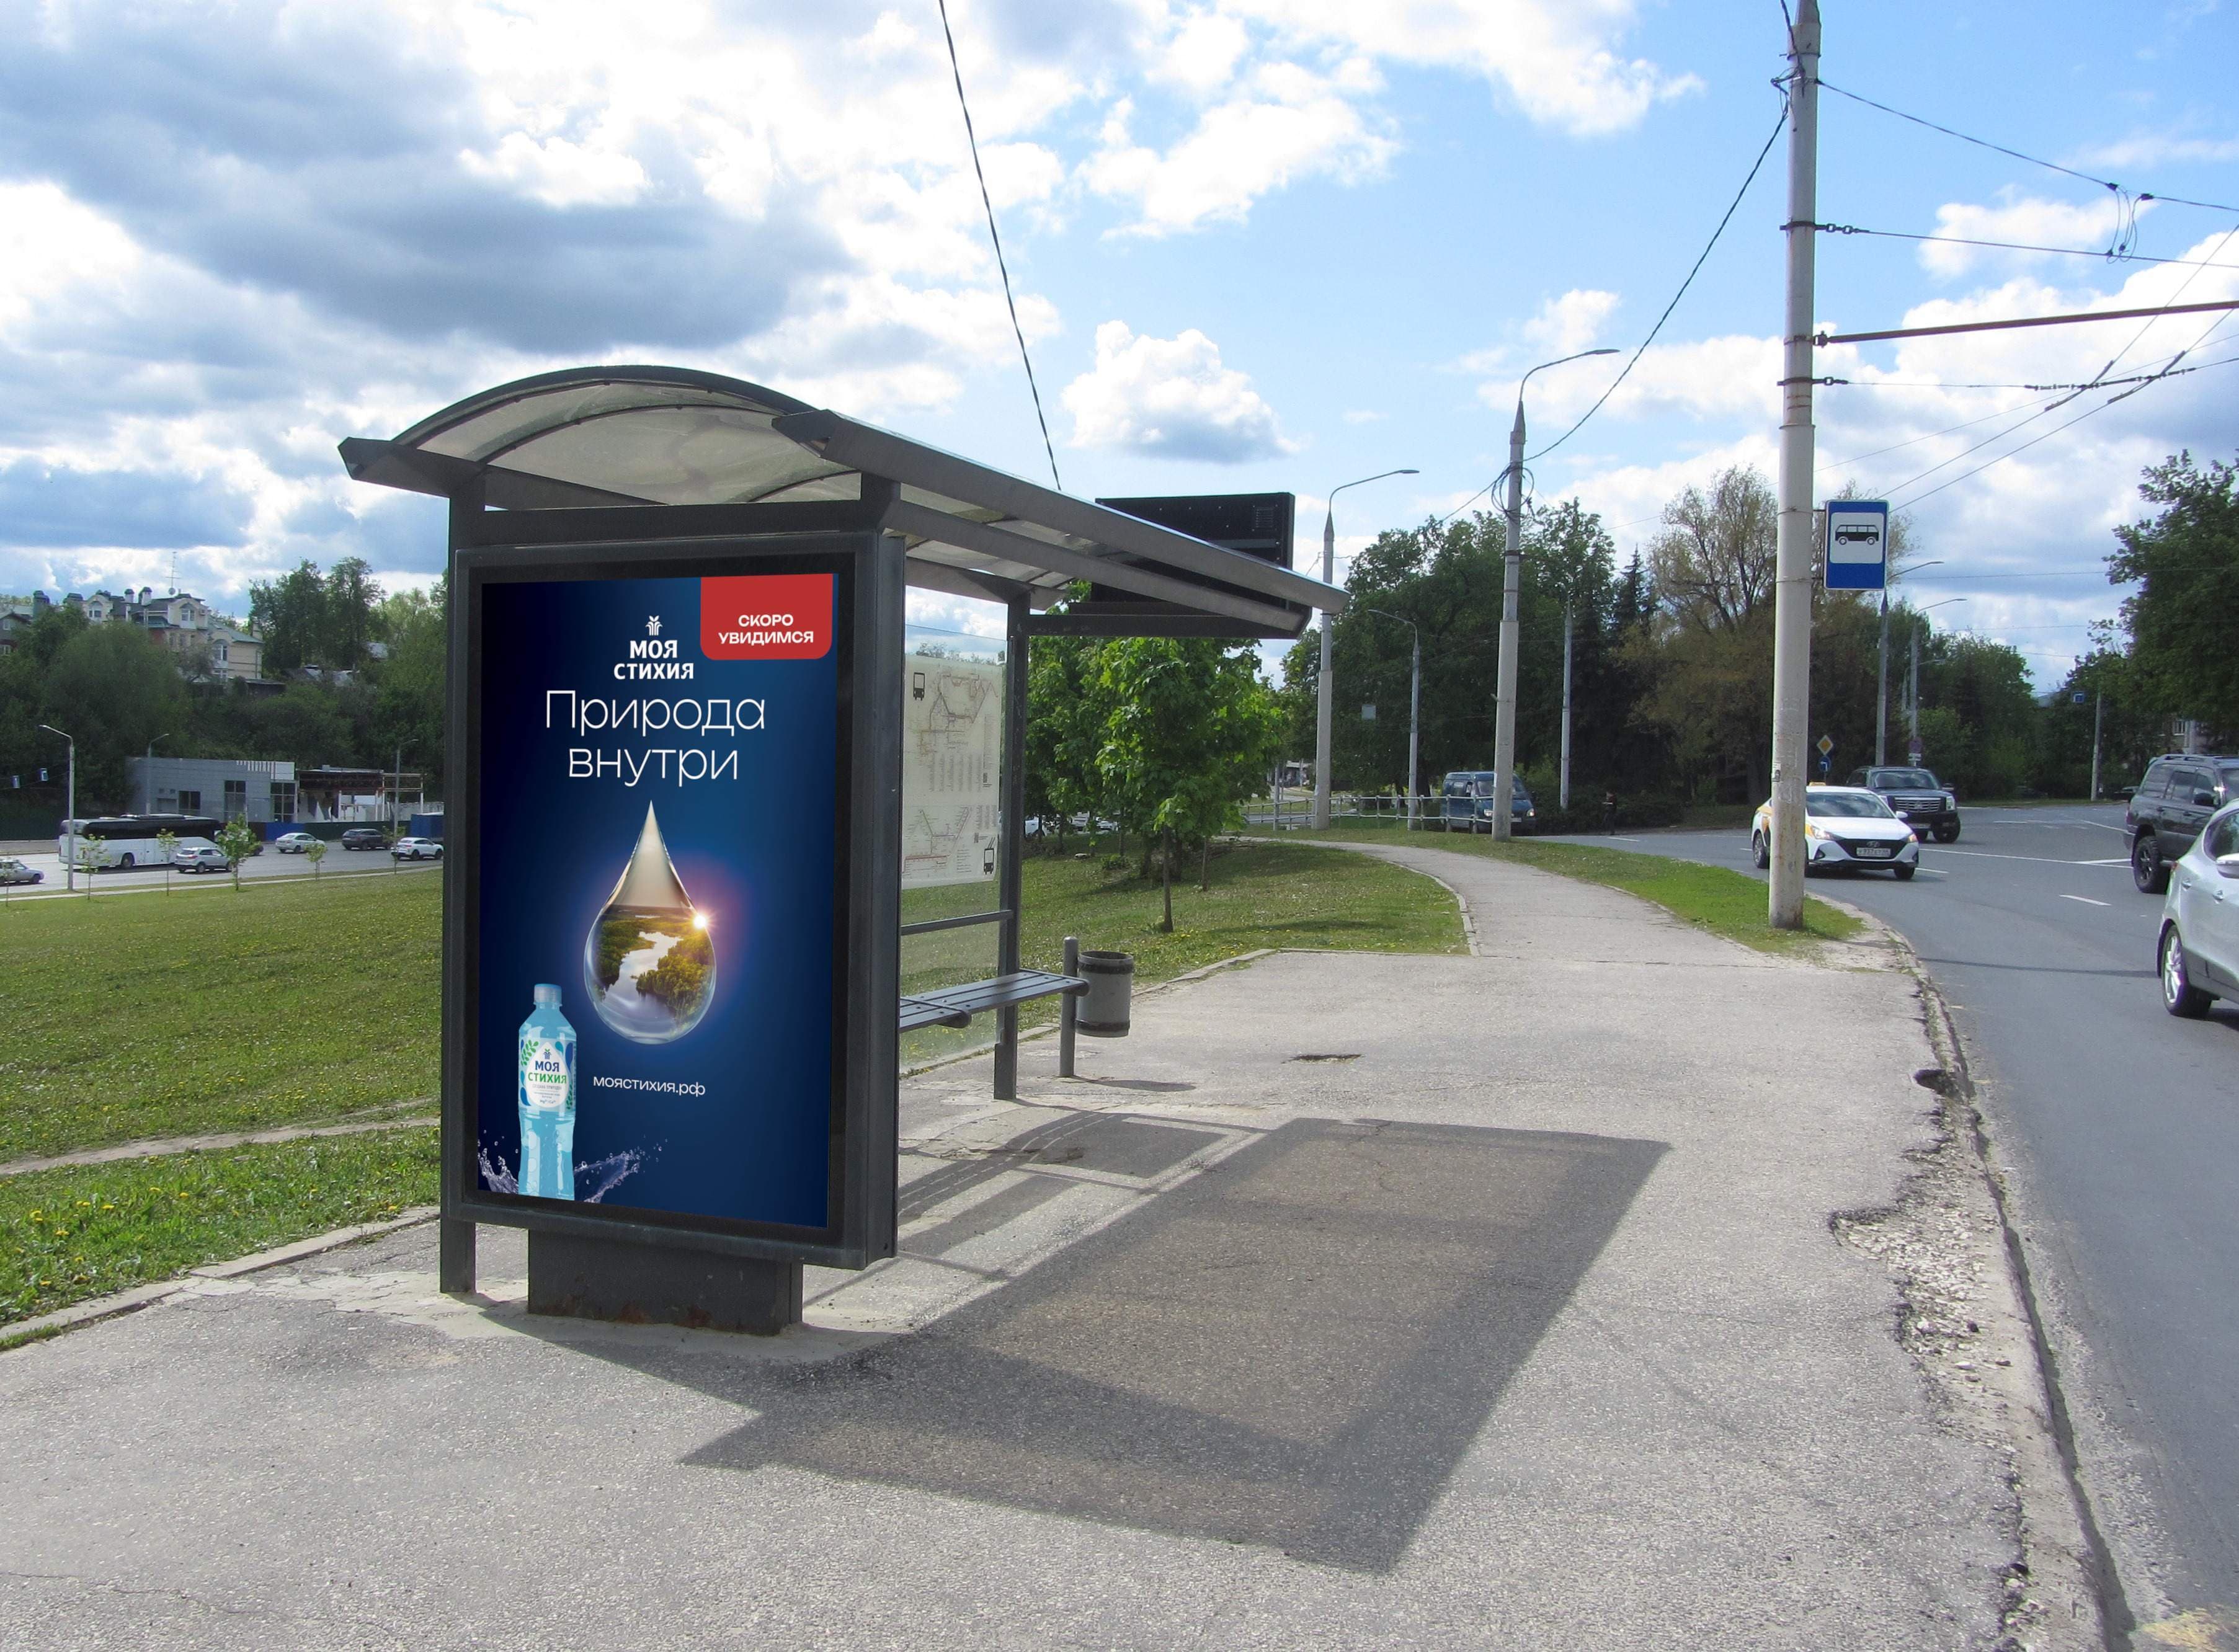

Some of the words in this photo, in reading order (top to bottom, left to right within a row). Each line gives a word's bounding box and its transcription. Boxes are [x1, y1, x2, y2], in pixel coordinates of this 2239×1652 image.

[738, 613, 794, 628] СКОРО
[718, 631, 814, 646] УВИДИМСЯ
[630, 639, 678, 659] МОЯ
[613, 662, 694, 680] СТИХИЯ
[546, 690, 765, 737] Природа
[569, 748, 738, 787] внутри
[535, 1060, 560, 1072] МОЯ
[528, 1072, 567, 1084] СТИХИЯ
[593, 1075, 706, 1097] моястихия.рф
